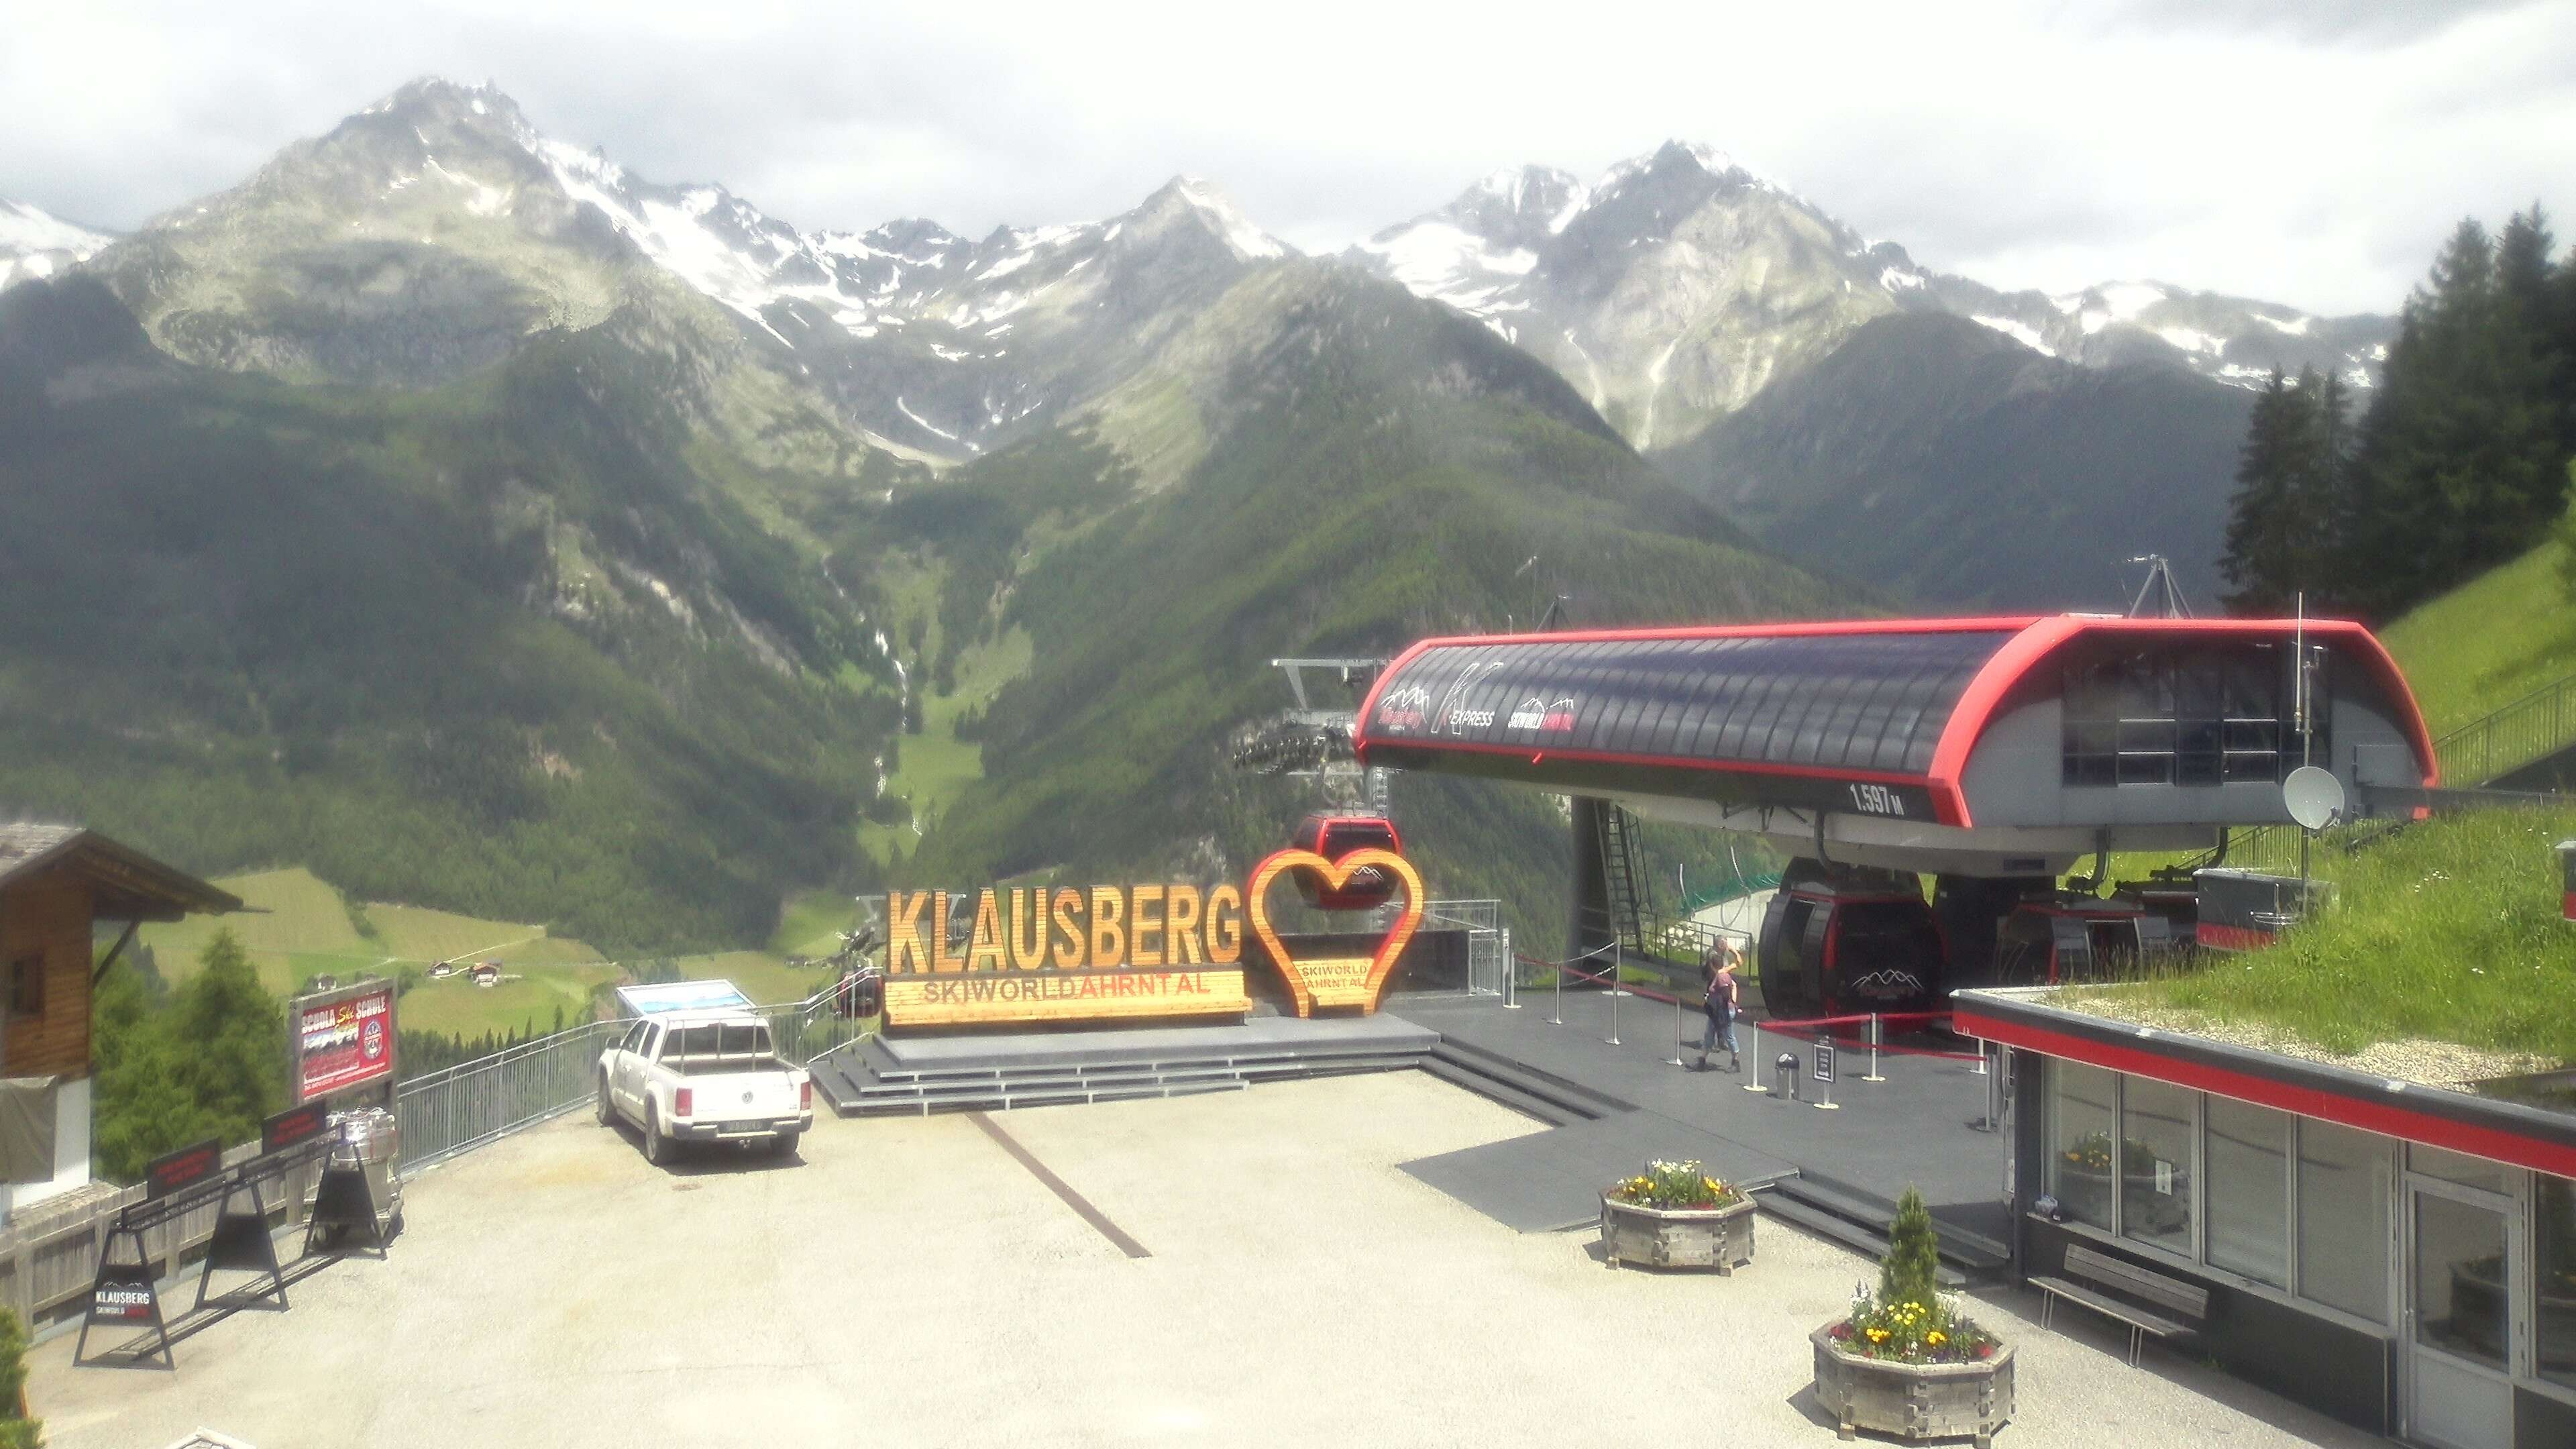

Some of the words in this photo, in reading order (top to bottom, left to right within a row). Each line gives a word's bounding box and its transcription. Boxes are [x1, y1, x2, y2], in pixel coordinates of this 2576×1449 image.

[1849, 784, 1890, 814] 1.597
[888, 884, 1241, 973] KLAUSBERG
[1302, 965, 1366, 977] SKIWORLD
[1306, 977, 1364, 989] AHRNTAL
[95, 1291, 150, 1304] KLAUSBERG
